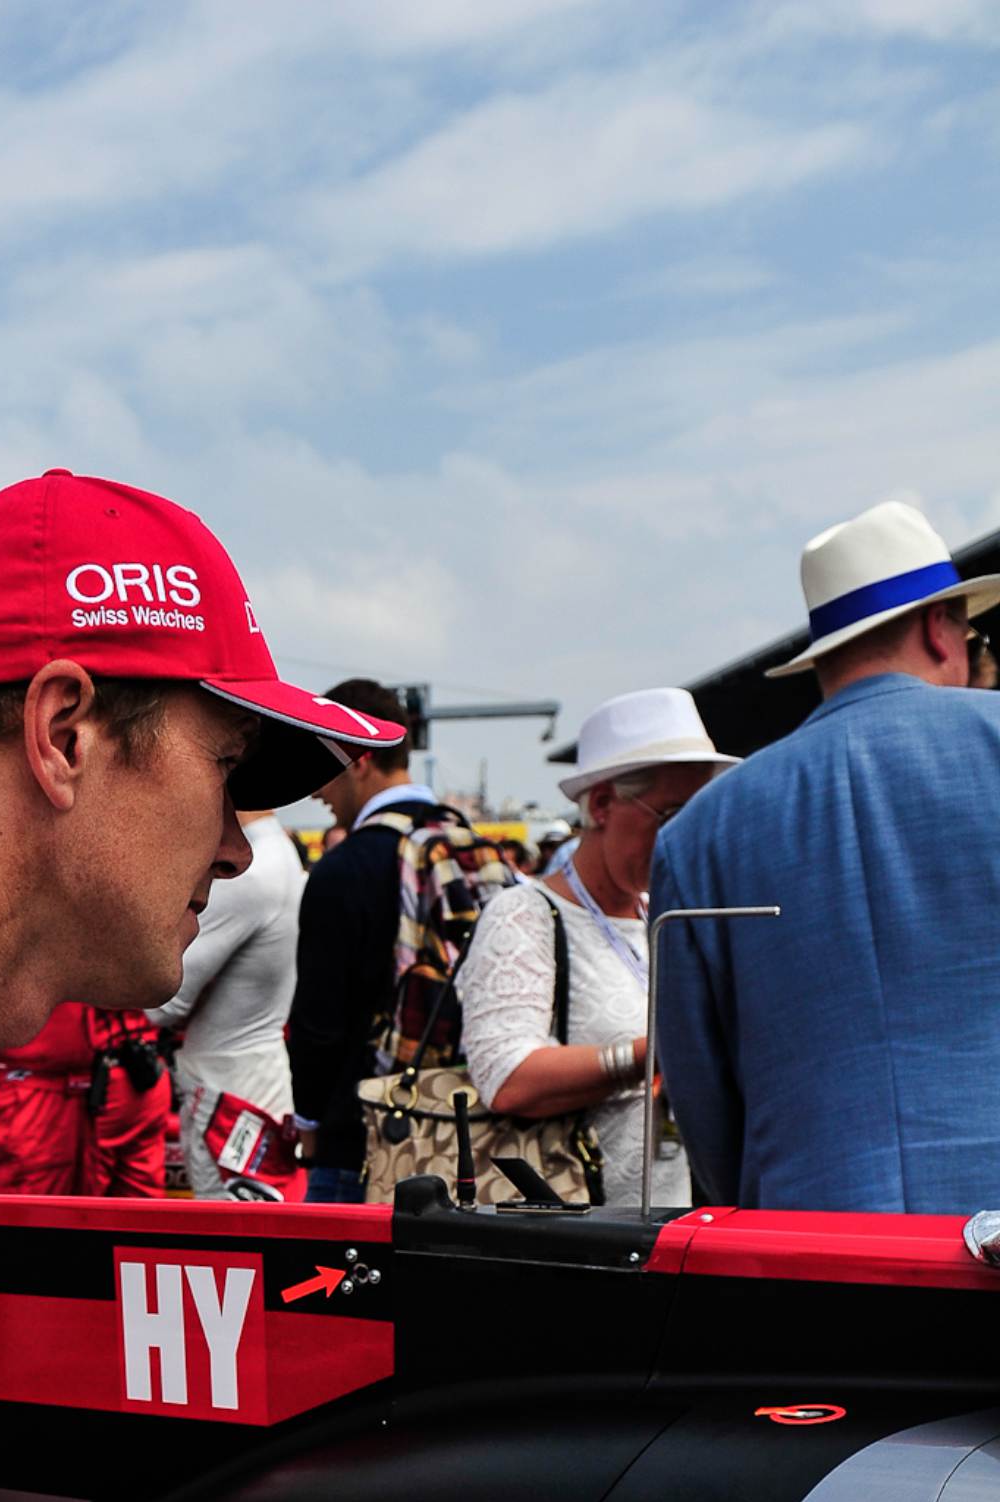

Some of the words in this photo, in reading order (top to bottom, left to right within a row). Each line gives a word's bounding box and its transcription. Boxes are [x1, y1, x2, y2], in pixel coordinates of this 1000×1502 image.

[65, 563, 201, 608] ORIS
[71, 606, 129, 628] Swiss
[132, 605, 205, 632] Watches
[119, 1261, 256, 1411] HY
